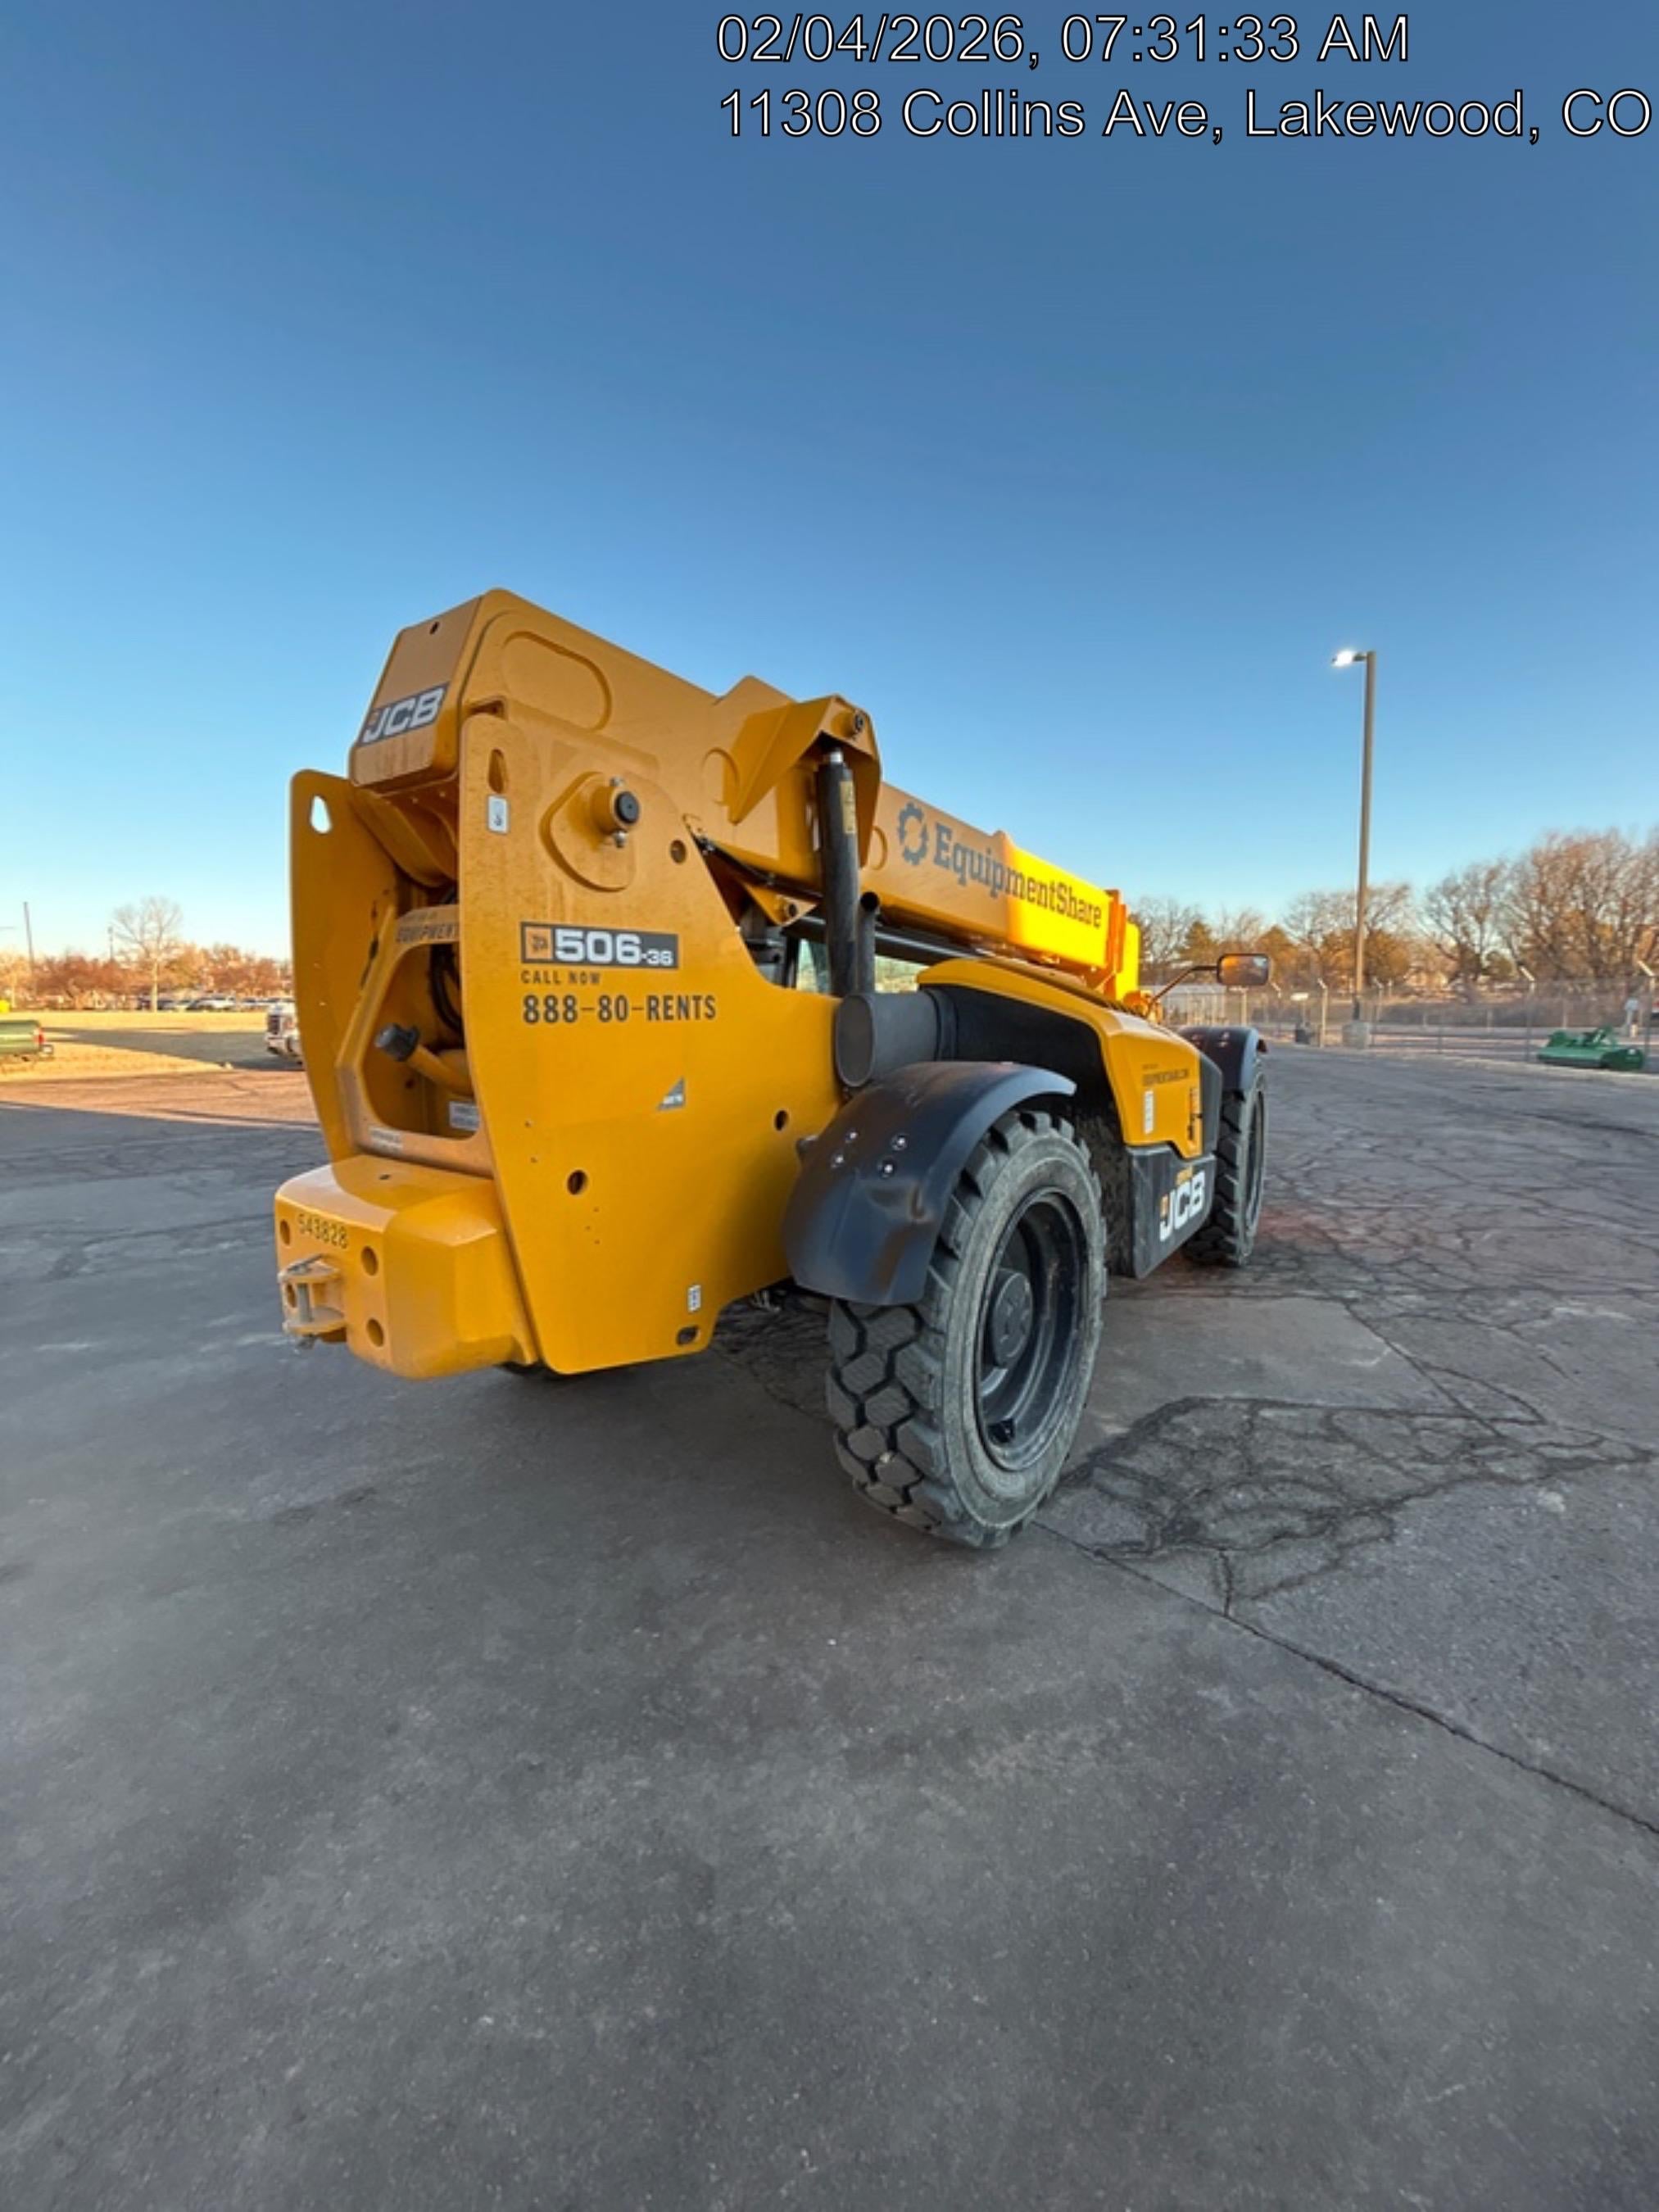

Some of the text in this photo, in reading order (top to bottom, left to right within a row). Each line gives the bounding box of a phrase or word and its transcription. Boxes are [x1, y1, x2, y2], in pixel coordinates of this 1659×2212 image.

[361, 687, 444, 744] JCB
[933, 822, 1102, 929] EquipmentShare
[520, 970, 601, 986] CALL NOW
[523, 994, 717, 1025] 888-80-RENTS
[1159, 1171, 1206, 1243] JCB
